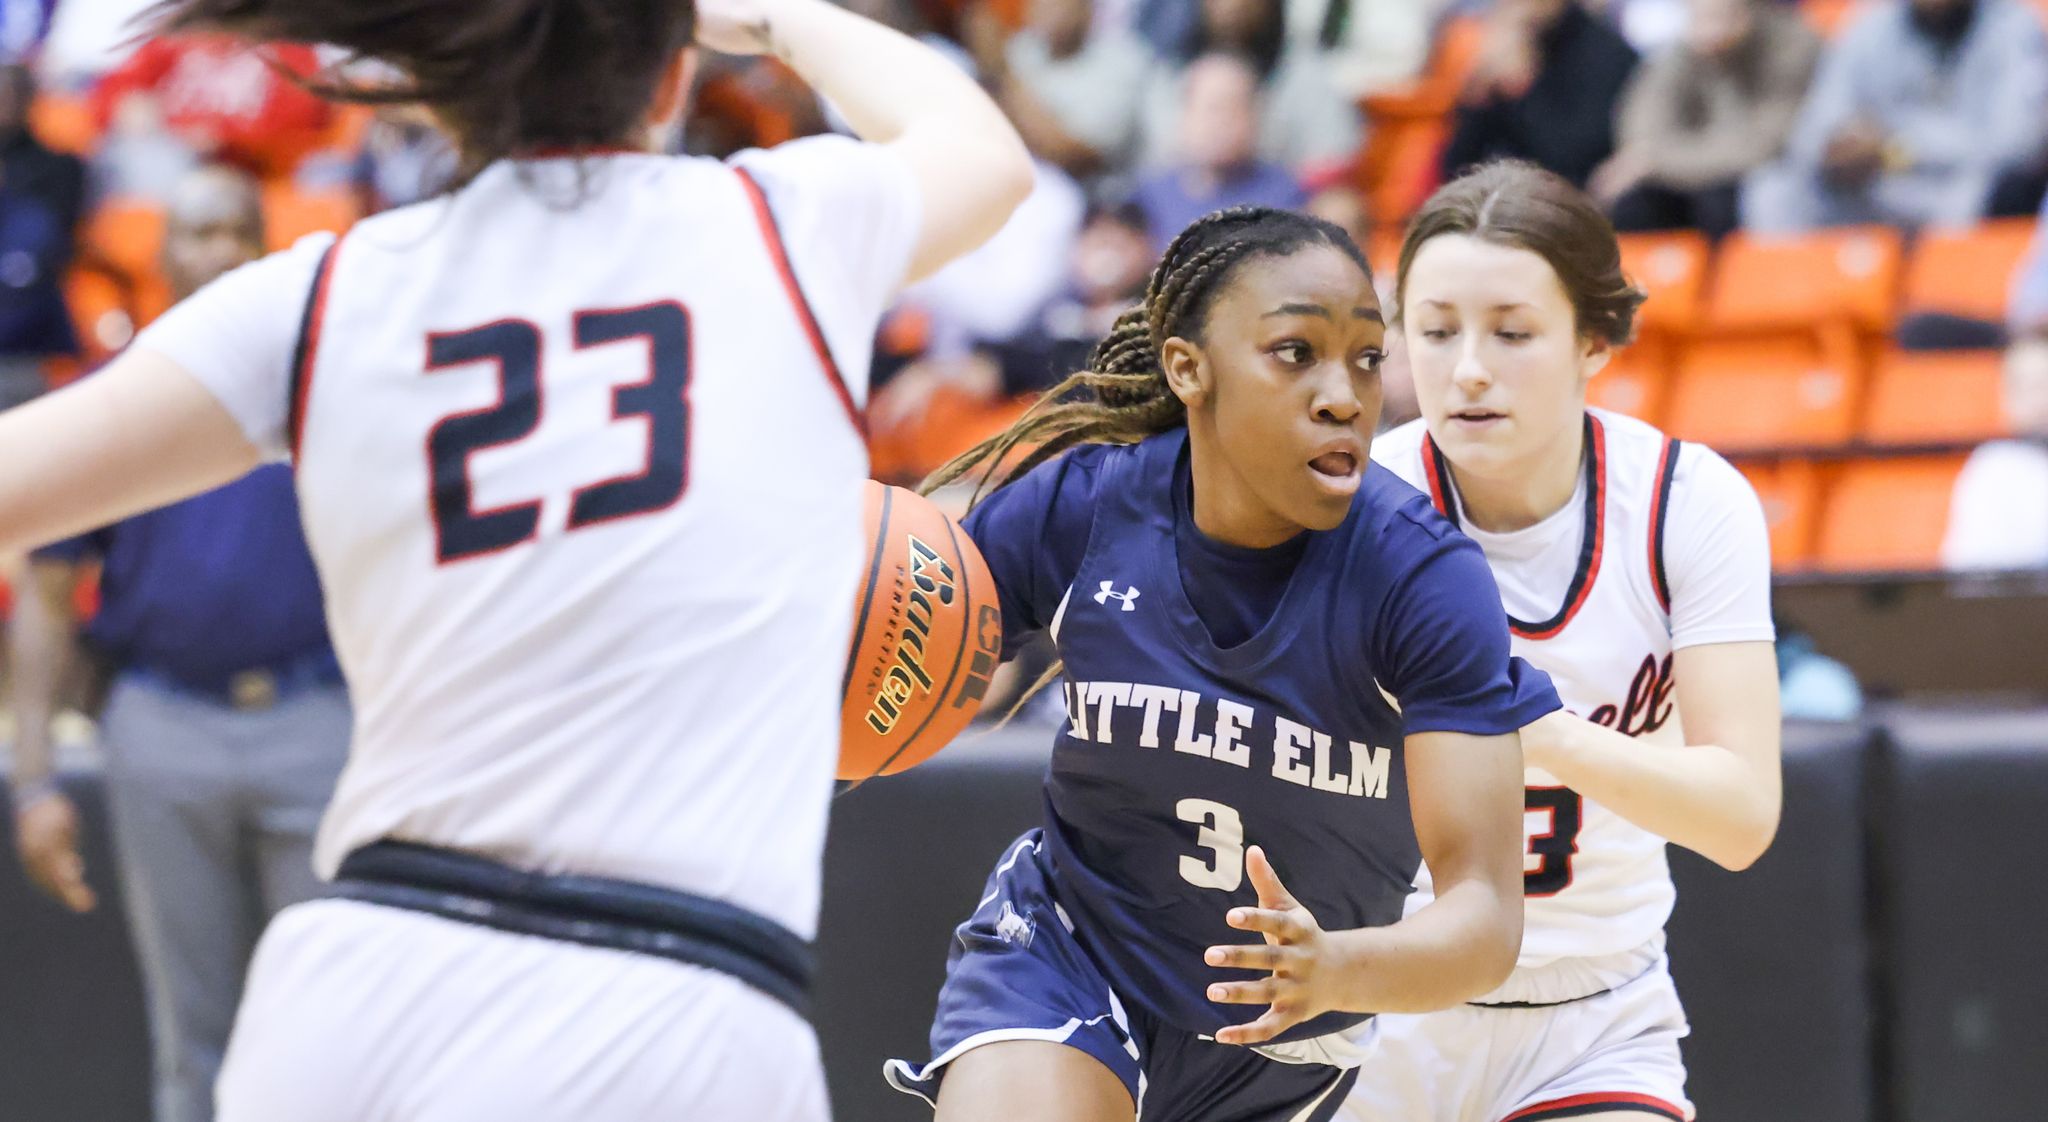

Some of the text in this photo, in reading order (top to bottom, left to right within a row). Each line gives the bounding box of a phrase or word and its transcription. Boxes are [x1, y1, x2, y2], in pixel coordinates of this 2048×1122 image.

[425, 298, 693, 568] 23
[864, 534, 956, 736] Baden
[1063, 681, 1392, 800] LITTLE ELM
[1175, 797, 1245, 893] 3
